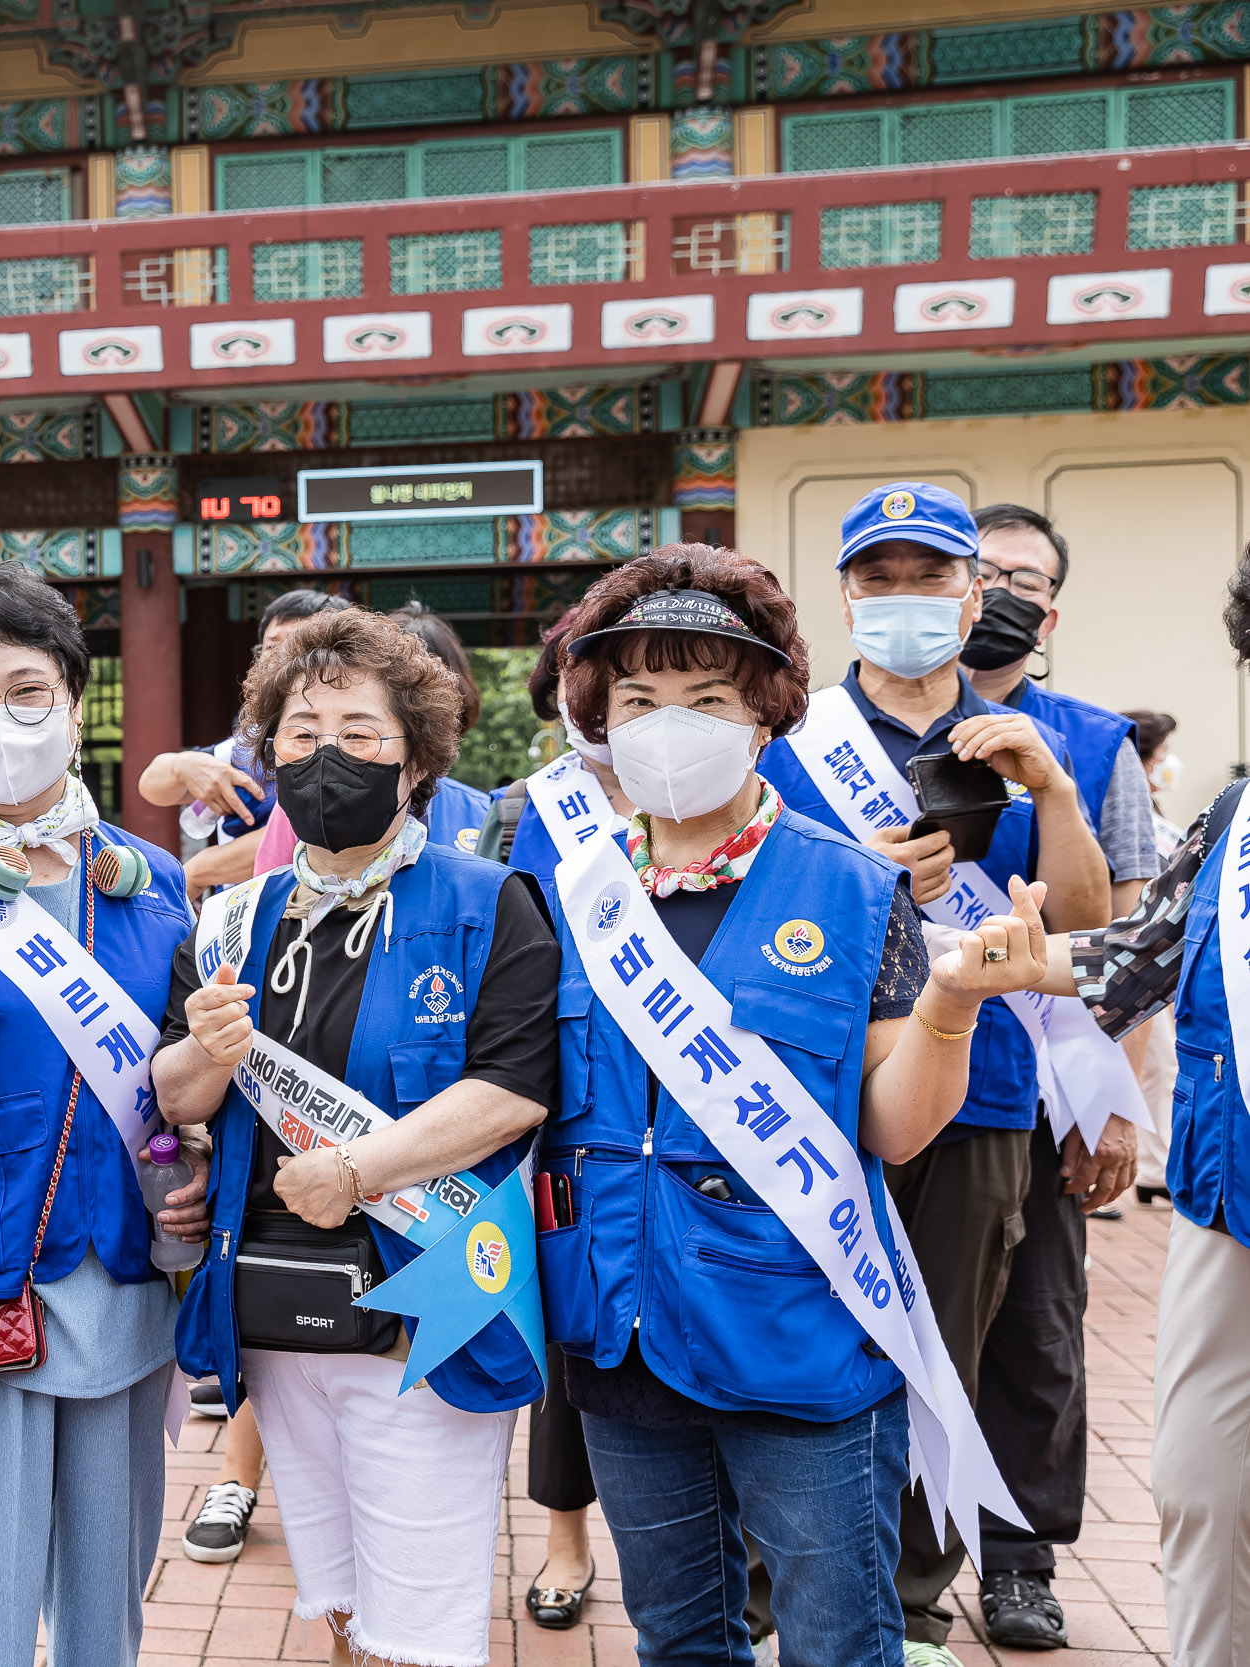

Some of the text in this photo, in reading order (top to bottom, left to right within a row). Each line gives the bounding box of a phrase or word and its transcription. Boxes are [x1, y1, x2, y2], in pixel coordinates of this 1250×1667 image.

[643, 601, 667, 611] SINCE
[698, 602, 722, 613] 1948
[824, 741, 875, 800] 법질서
[415, 1011, 466, 1024] 바르게살기운동
[295, 1315, 335, 1329] SPORT
